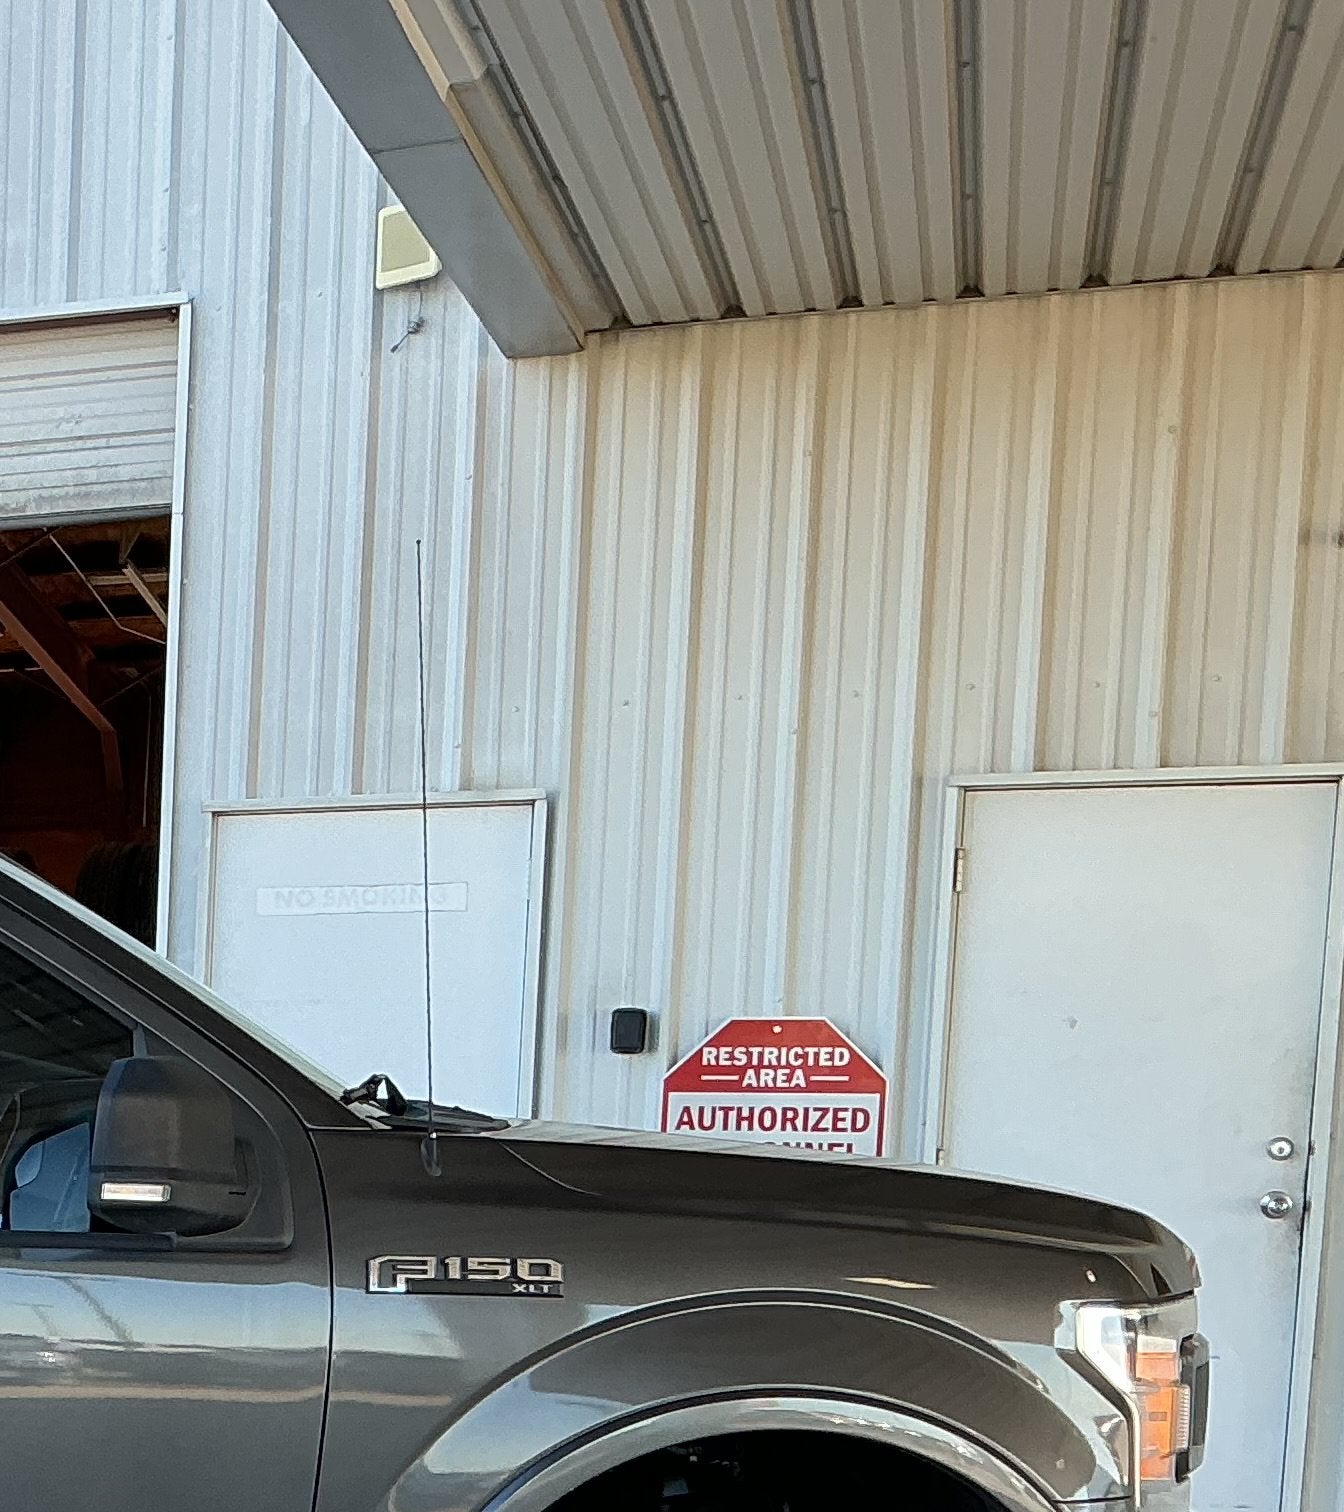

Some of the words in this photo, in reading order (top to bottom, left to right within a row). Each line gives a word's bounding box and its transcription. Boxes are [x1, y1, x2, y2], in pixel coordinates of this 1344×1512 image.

[274, 889, 316, 908] NO
[322, 886, 449, 908] SMOKING
[701, 1046, 851, 1067] RESTRICTED
[741, 1068, 807, 1088] AREA
[674, 1105, 872, 1133] AUTHORIZED
[512, 1283, 554, 1294] XLT
